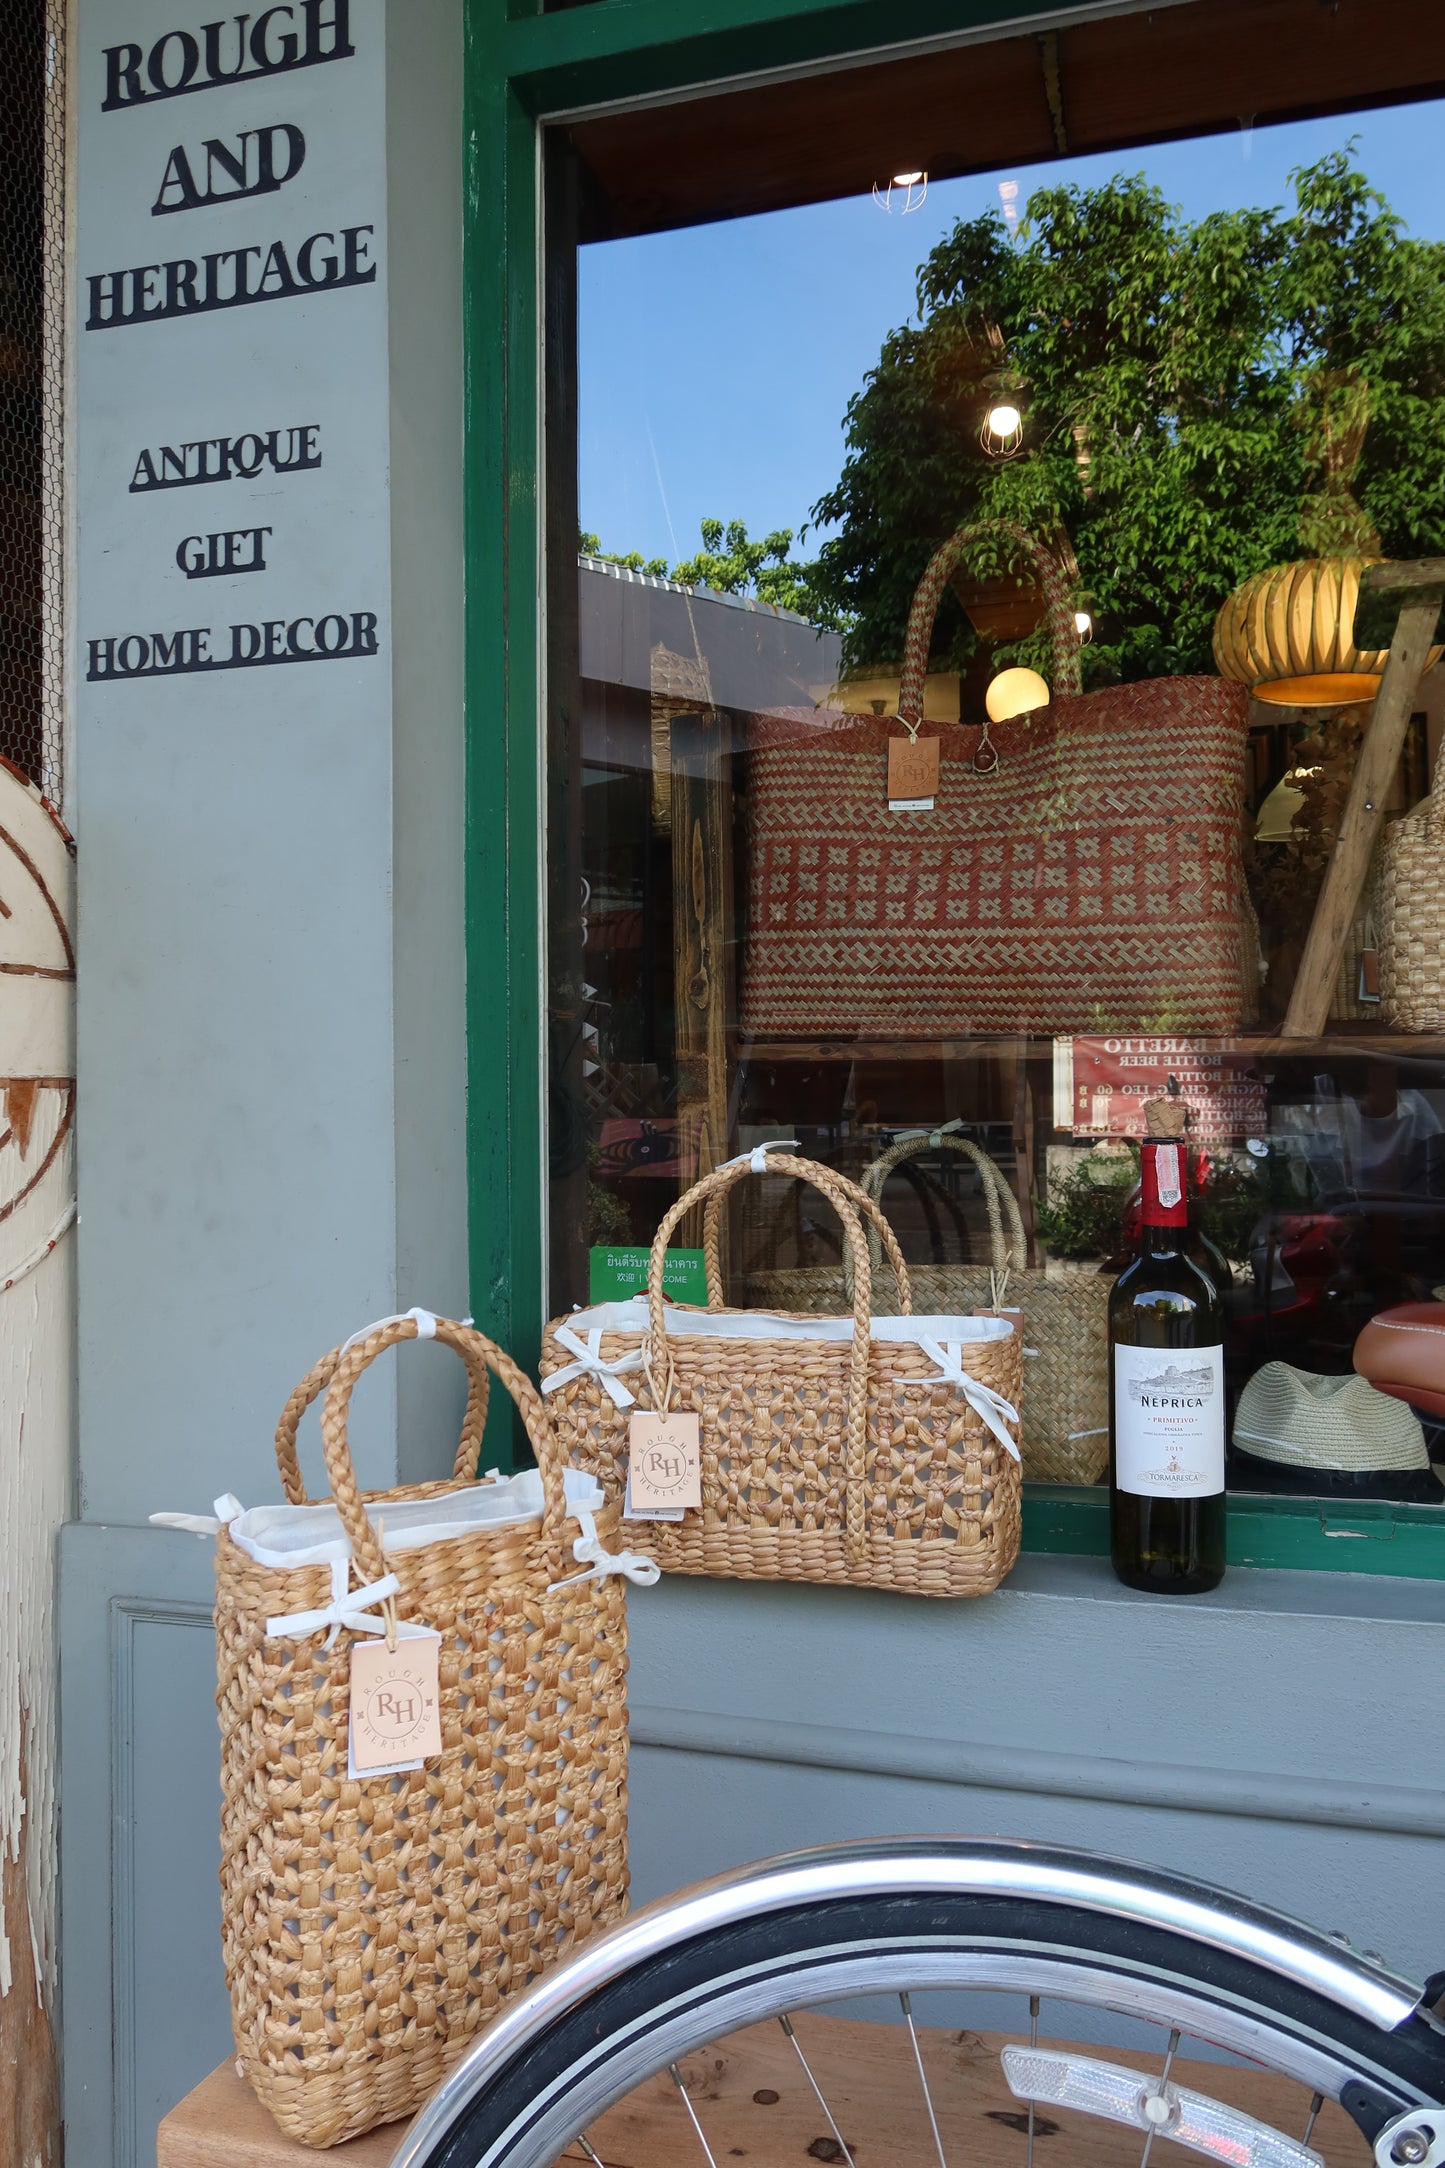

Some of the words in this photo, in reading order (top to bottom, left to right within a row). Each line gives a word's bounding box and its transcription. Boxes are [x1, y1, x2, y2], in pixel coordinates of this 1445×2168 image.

[102, 0, 355, 111] ROUGH
[151, 123, 305, 215] AND
[85, 225, 376, 330] HERITAGE
[129, 425, 322, 493] ANTIQUE
[176, 526, 272, 579] GIFT
[87, 627, 211, 682] HOME
[231, 612, 378, 670] DECOR
[616, 1273, 635, 1283] 欢迎
[645, 1275, 688, 1284] COME
[638, 1435, 687, 1455] ROUGH
[648, 1452, 681, 1478] RH
[1149, 1473, 1199, 1482] TORMARESCA
[640, 1472, 693, 1497] HERITAGE
[363, 1670, 425, 1696] ROUGH
[376, 1692, 416, 1725] RH
[363, 1714, 431, 1750] HERITAGE
